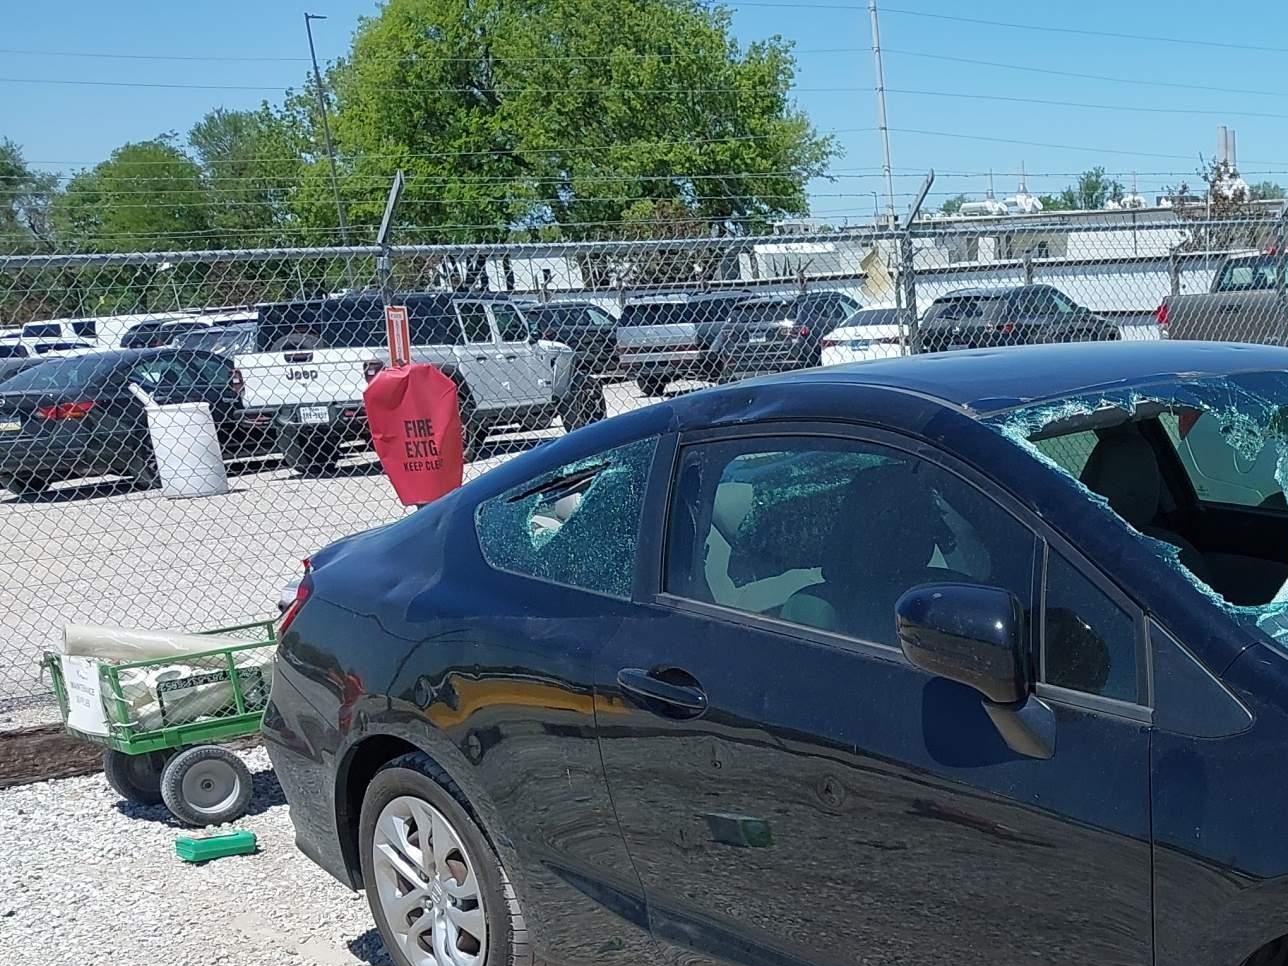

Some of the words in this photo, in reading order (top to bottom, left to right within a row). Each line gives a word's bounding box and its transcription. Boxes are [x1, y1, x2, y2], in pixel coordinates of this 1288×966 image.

[285, 368, 318, 381] Jeep
[404, 418, 435, 438] FIRE
[403, 461, 424, 472] KEEP
